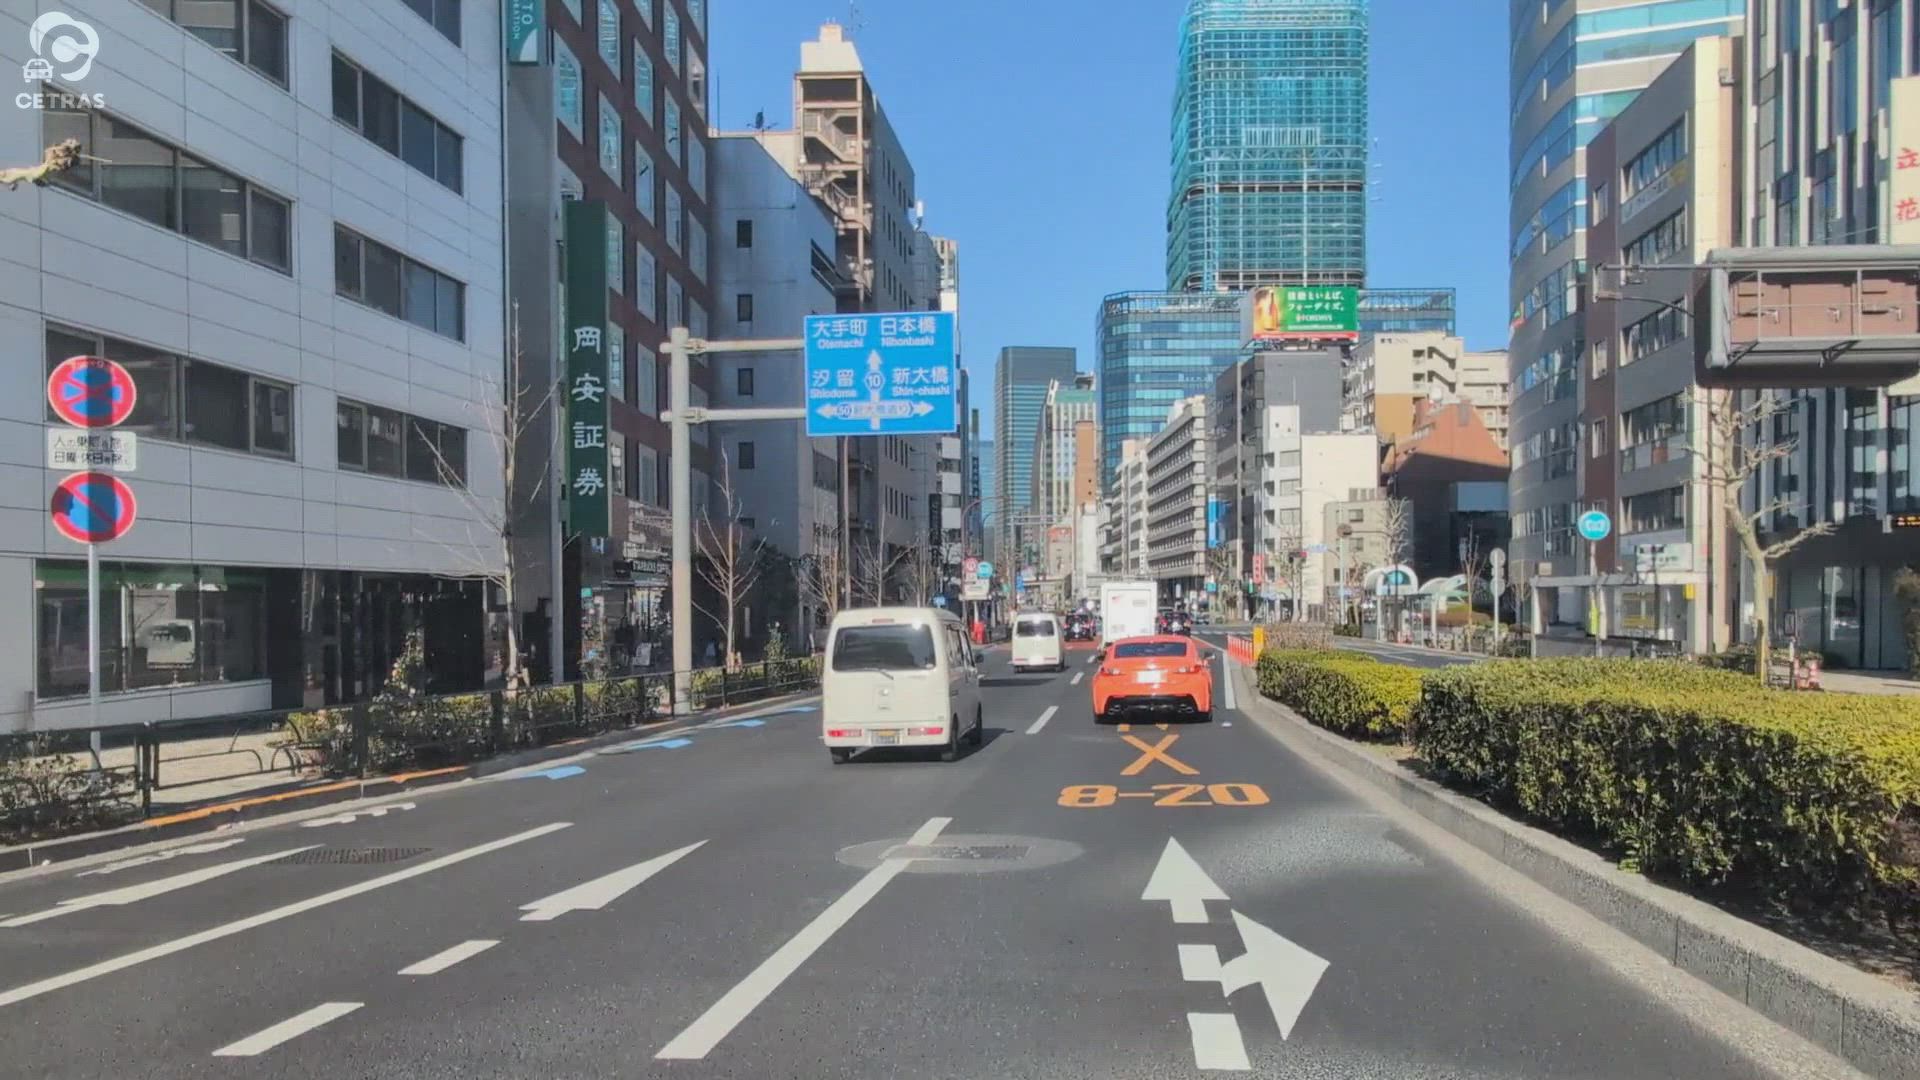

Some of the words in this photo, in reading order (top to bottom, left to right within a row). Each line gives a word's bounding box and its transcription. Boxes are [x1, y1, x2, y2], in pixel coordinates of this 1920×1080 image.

[812, 318, 868, 338] 大手町
[881, 316, 936, 336] 日本橋
[812, 369, 855, 388] 汐留
[892, 366, 949, 385] 新大橋
[867, 374, 881, 387] 10
[571, 325, 606, 497] 岡安証券
[1057, 783, 1271, 807] 8-20
